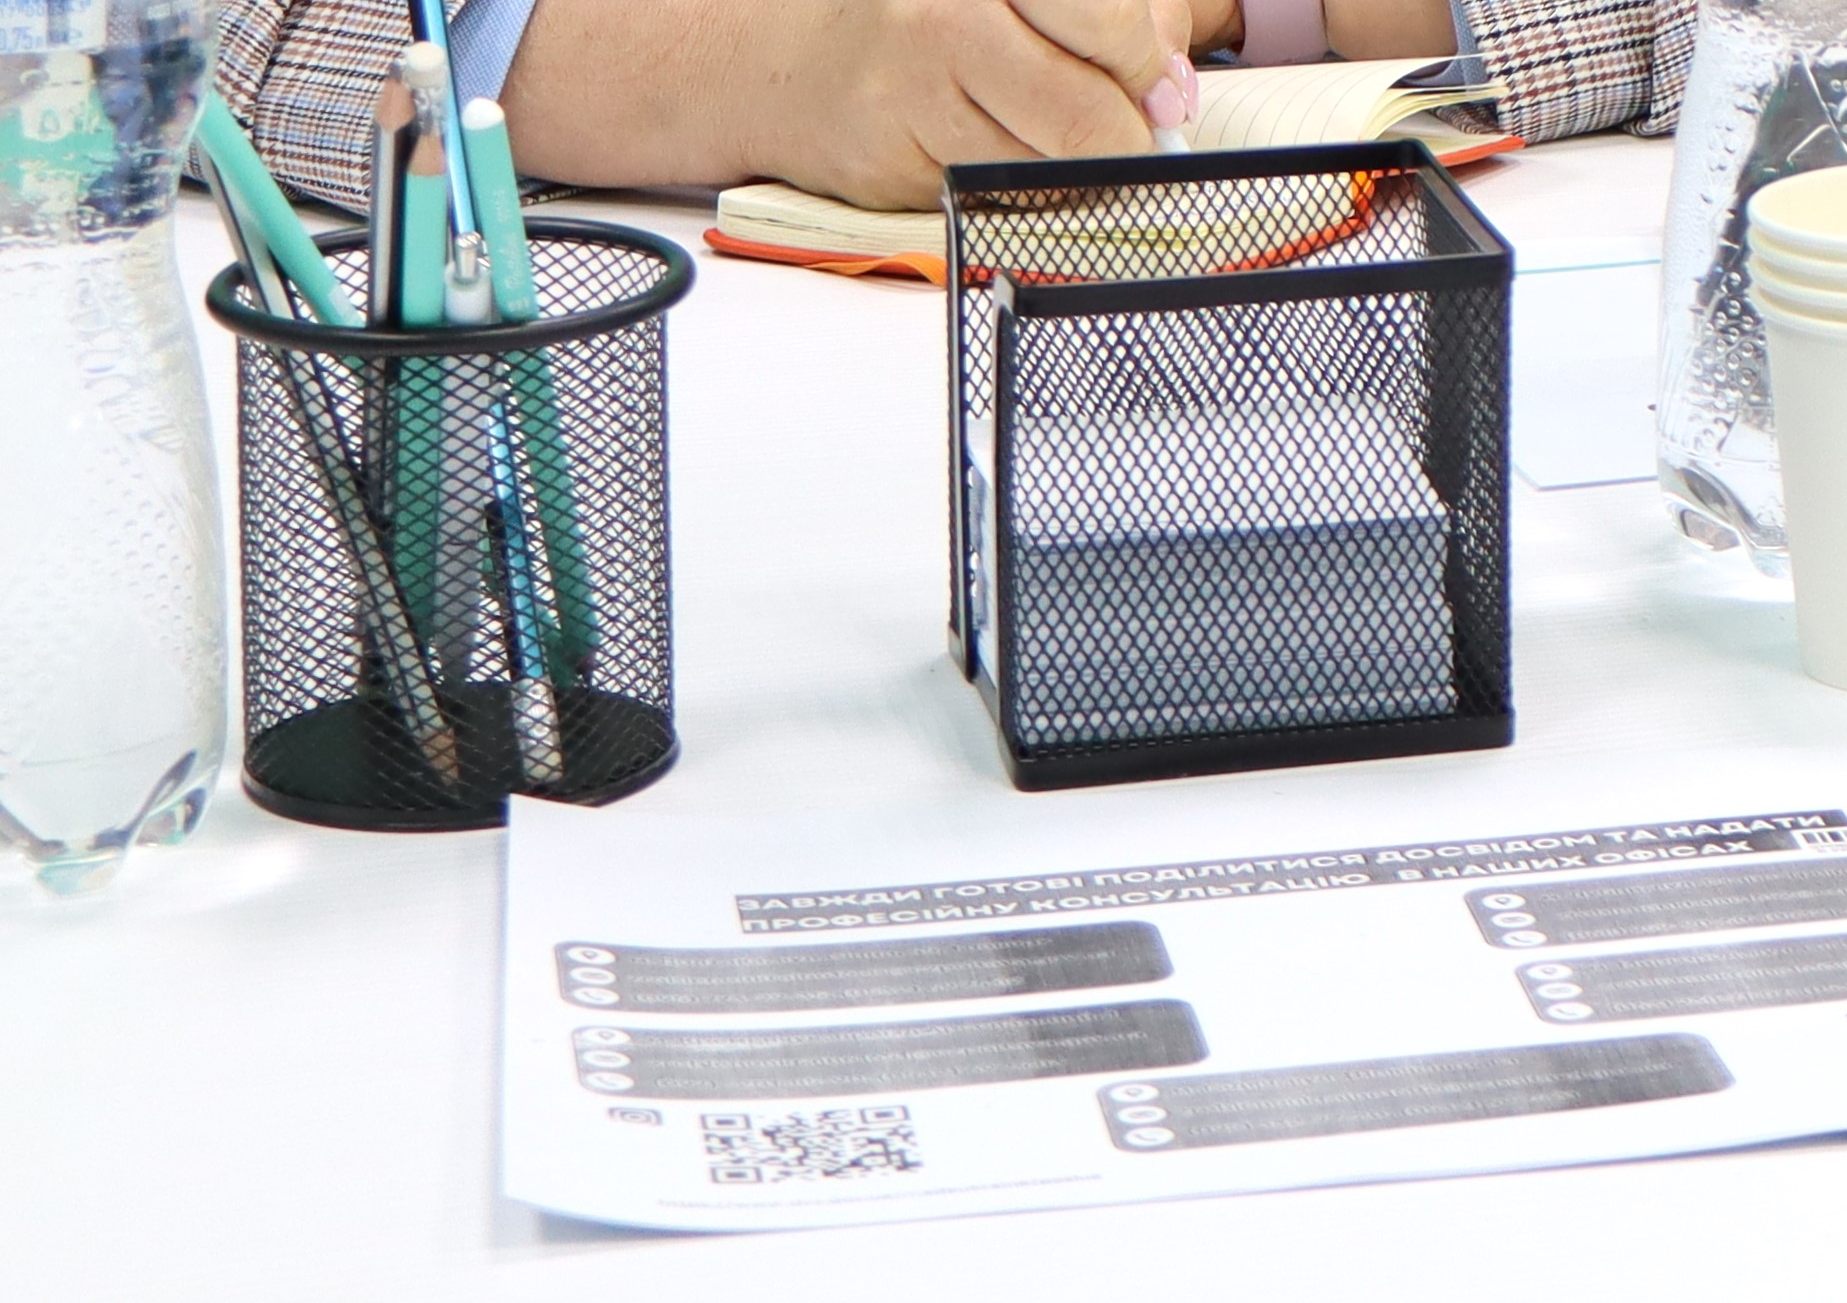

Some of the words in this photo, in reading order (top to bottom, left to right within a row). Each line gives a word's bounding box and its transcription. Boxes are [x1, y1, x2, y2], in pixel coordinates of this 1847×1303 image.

[738, 888, 921, 911] ЗАВЖДИ
[933, 876, 1085, 899] ГОТОВІ
[1095, 851, 1366, 887] ПОДІЛИТИСЯ
[1375, 831, 1597, 867] ДОСВІДОМ
[1605, 828, 1655, 848] ТА
[1663, 811, 1827, 842] НАДАТИ
[743, 900, 1019, 932] ПРОФЕСІЙНУ
[1032, 872, 1369, 912] КОНСУЛЬТАЦІЮ
[1399, 869, 1419, 882] В
[1424, 853, 1588, 881] НАШИХ
[1601, 838, 1755, 867] ОФІСАХ
